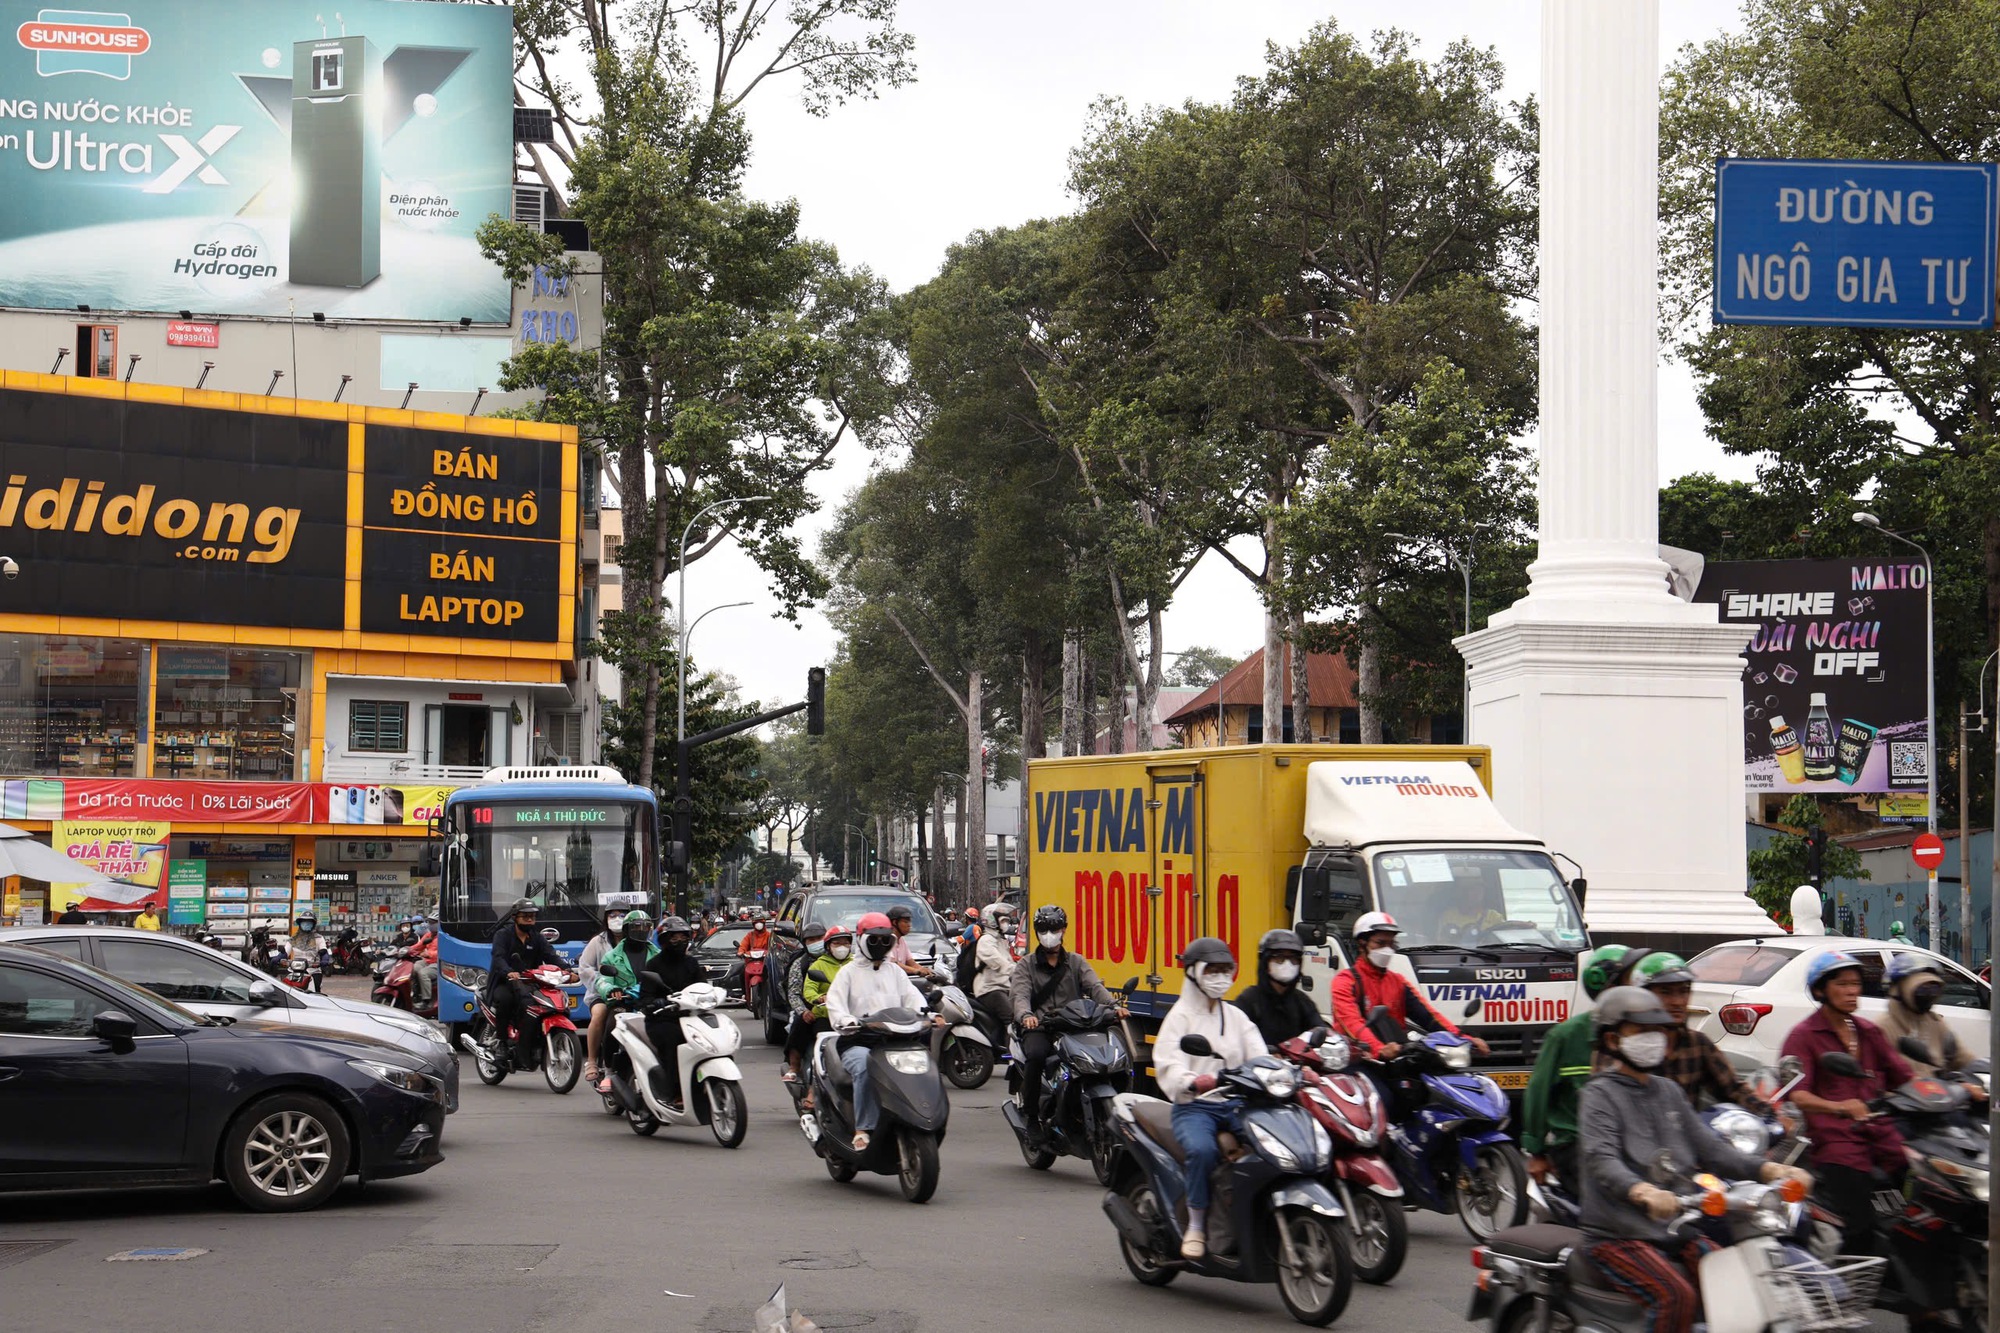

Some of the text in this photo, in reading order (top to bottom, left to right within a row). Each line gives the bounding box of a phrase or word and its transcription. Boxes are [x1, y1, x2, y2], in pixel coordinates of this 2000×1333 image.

[30, 29, 138, 48] SUNHOUSE
[44, 98, 120, 123] NƯỚC
[126, 102, 193, 127] KHỎE
[389, 194, 449, 208] Điện phân
[1776, 180, 1934, 226] ĐƯỜNG
[397, 206, 460, 219] nước khỏe
[193, 240, 258, 260] Gấp đôi
[173, 258, 278, 280] Hydrogen
[1737, 242, 1972, 317] NGÔ GIA TỰ
[193, 325, 213, 334] WIN
[433, 446, 499, 481] BÁN
[391, 481, 539, 526] ĐỒNG HỒ
[430, 549, 495, 583] BÁN
[1851, 564, 1926, 591] MALTO
[400, 594, 524, 627] LAPTOP
[1727, 592, 1835, 617] SHAKE
[1743, 617, 1881, 653] OÀI NGHI
[1813, 652, 1879, 676] OFF
[1771, 731, 1797, 747] MALTO
[1841, 724, 1868, 741] MALTO
[1804, 745, 1835, 758] MALTO
[1340, 776, 1431, 786] VIETNAM
[1752, 773, 1774, 783] Young
[106, 792, 132, 808] Trả
[137, 793, 184, 809] Trước
[1395, 784, 1479, 798] moving
[202, 793, 292, 811] 0% Lãi Suất
[472, 808, 493, 824] 10
[516, 808, 606, 822] NGÃ 4 THỦ ĐỨC
[67, 827, 156, 839] LAPTOP VƯỢT TRỘI
[66, 839, 133, 860] GIÁ RẺ
[98, 859, 148, 878] THẬT!
[1475, 969, 1526, 980] ISUZU
[1428, 984, 1526, 1001] VIETNAM
[1483, 998, 1568, 1023] moving
